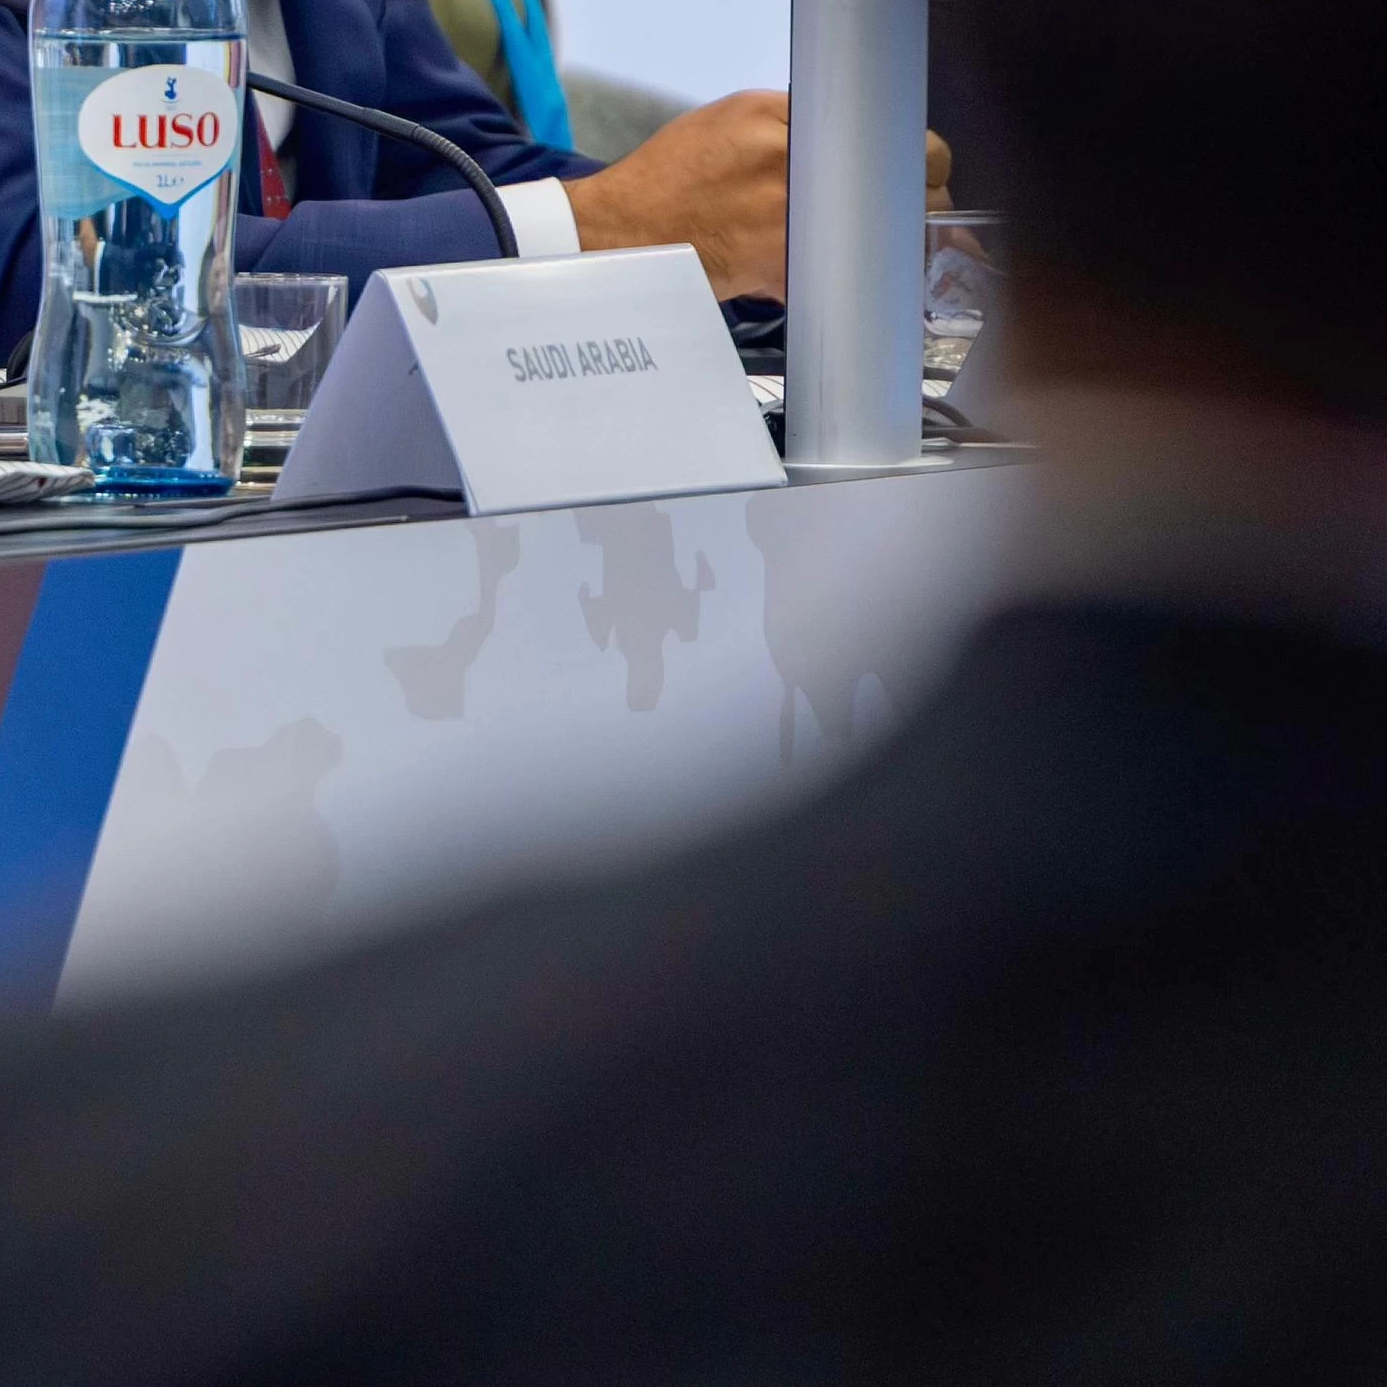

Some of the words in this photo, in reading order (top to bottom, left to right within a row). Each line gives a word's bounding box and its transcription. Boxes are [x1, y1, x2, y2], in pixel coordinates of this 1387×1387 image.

[111, 112, 220, 149] LUSO
[505, 342, 576, 383] SAUDI
[576, 336, 660, 377] ARABIA
